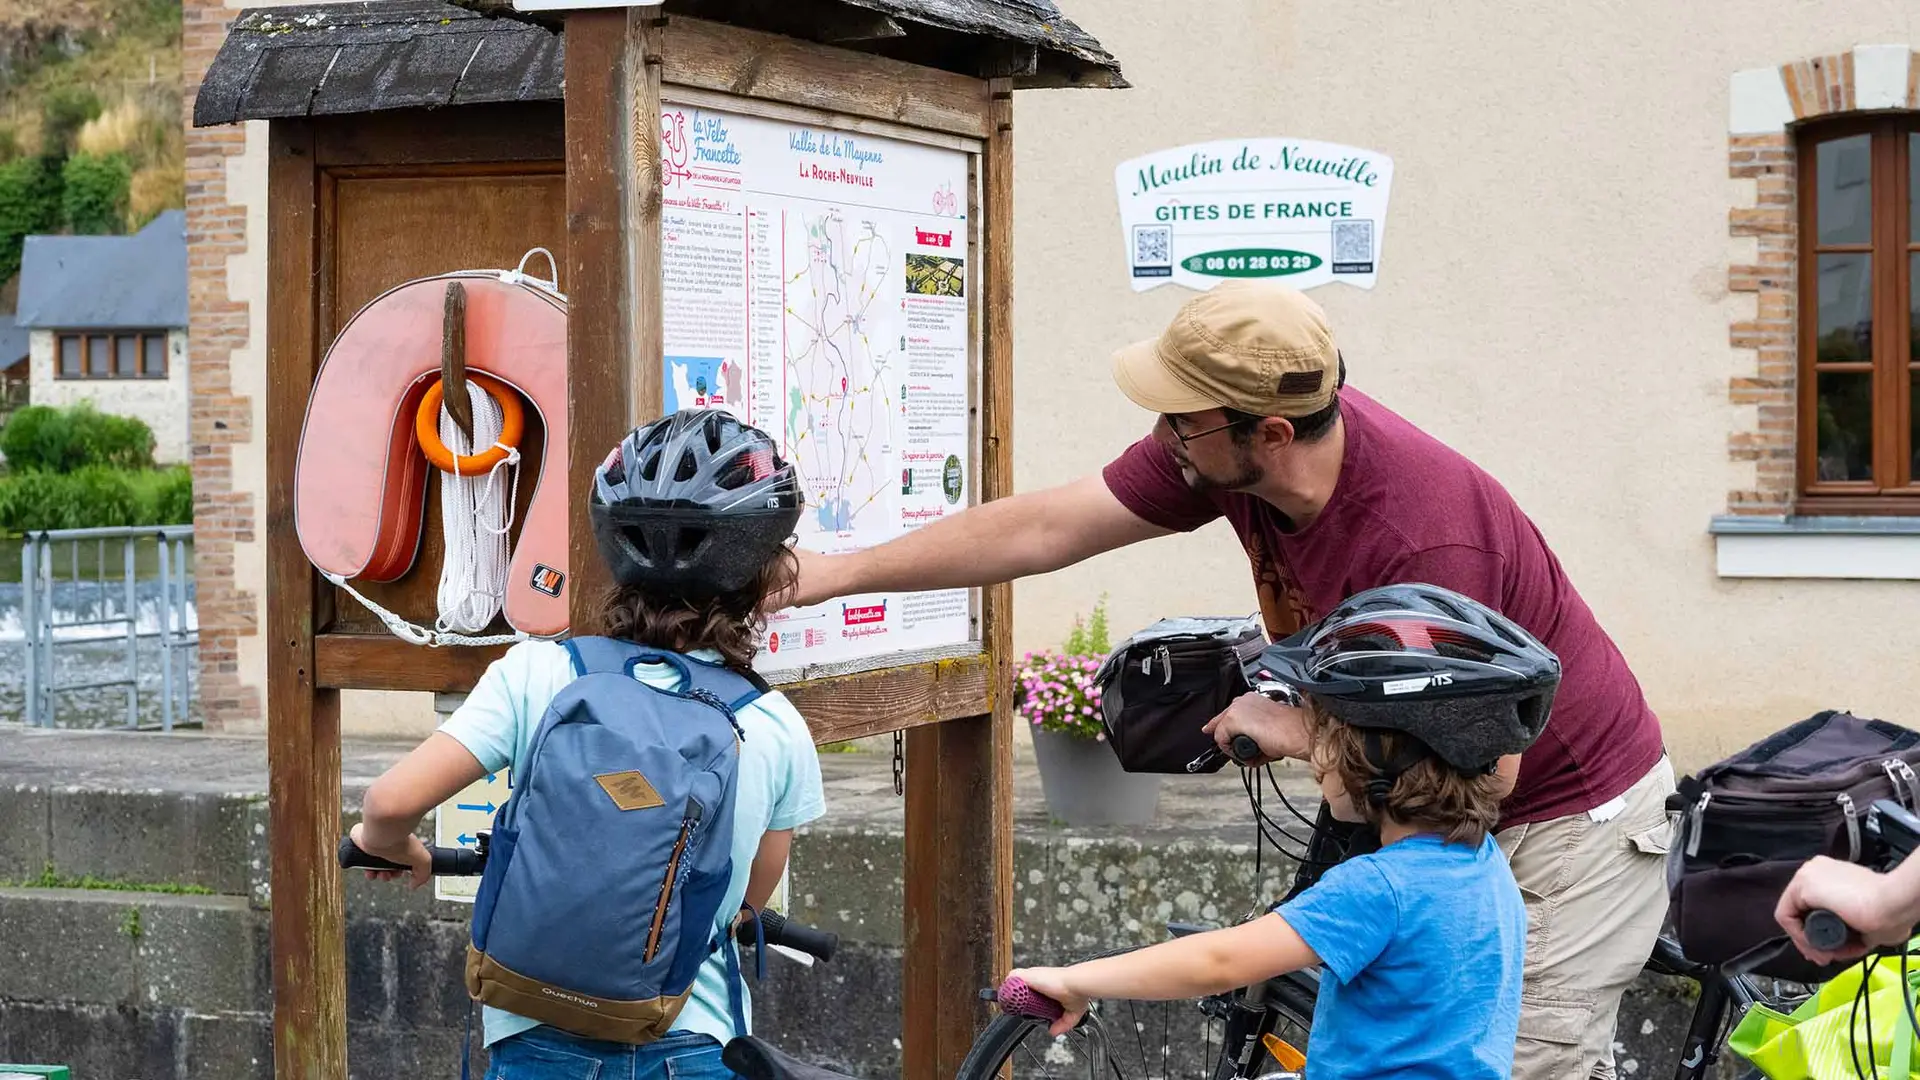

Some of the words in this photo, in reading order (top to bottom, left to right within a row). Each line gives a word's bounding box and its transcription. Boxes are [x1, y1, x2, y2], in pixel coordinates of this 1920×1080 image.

[789, 130, 817, 153] Vallée
[819, 134, 830, 155] de
[832, 136, 842, 156] la
[844, 140, 883, 170] Mayenne
[1133, 152, 1224, 196] Moulin
[1232, 146, 1260, 171] de
[1269, 146, 1378, 187] Neuville
[1228, 203, 1256, 219] DE
[1263, 201, 1352, 218] FRANCE
[1227, 257, 1245, 270] 01
[1270, 256, 1290, 269] 03
[1292, 255, 1312, 269] 29
[542, 987, 598, 1008] Quechua
